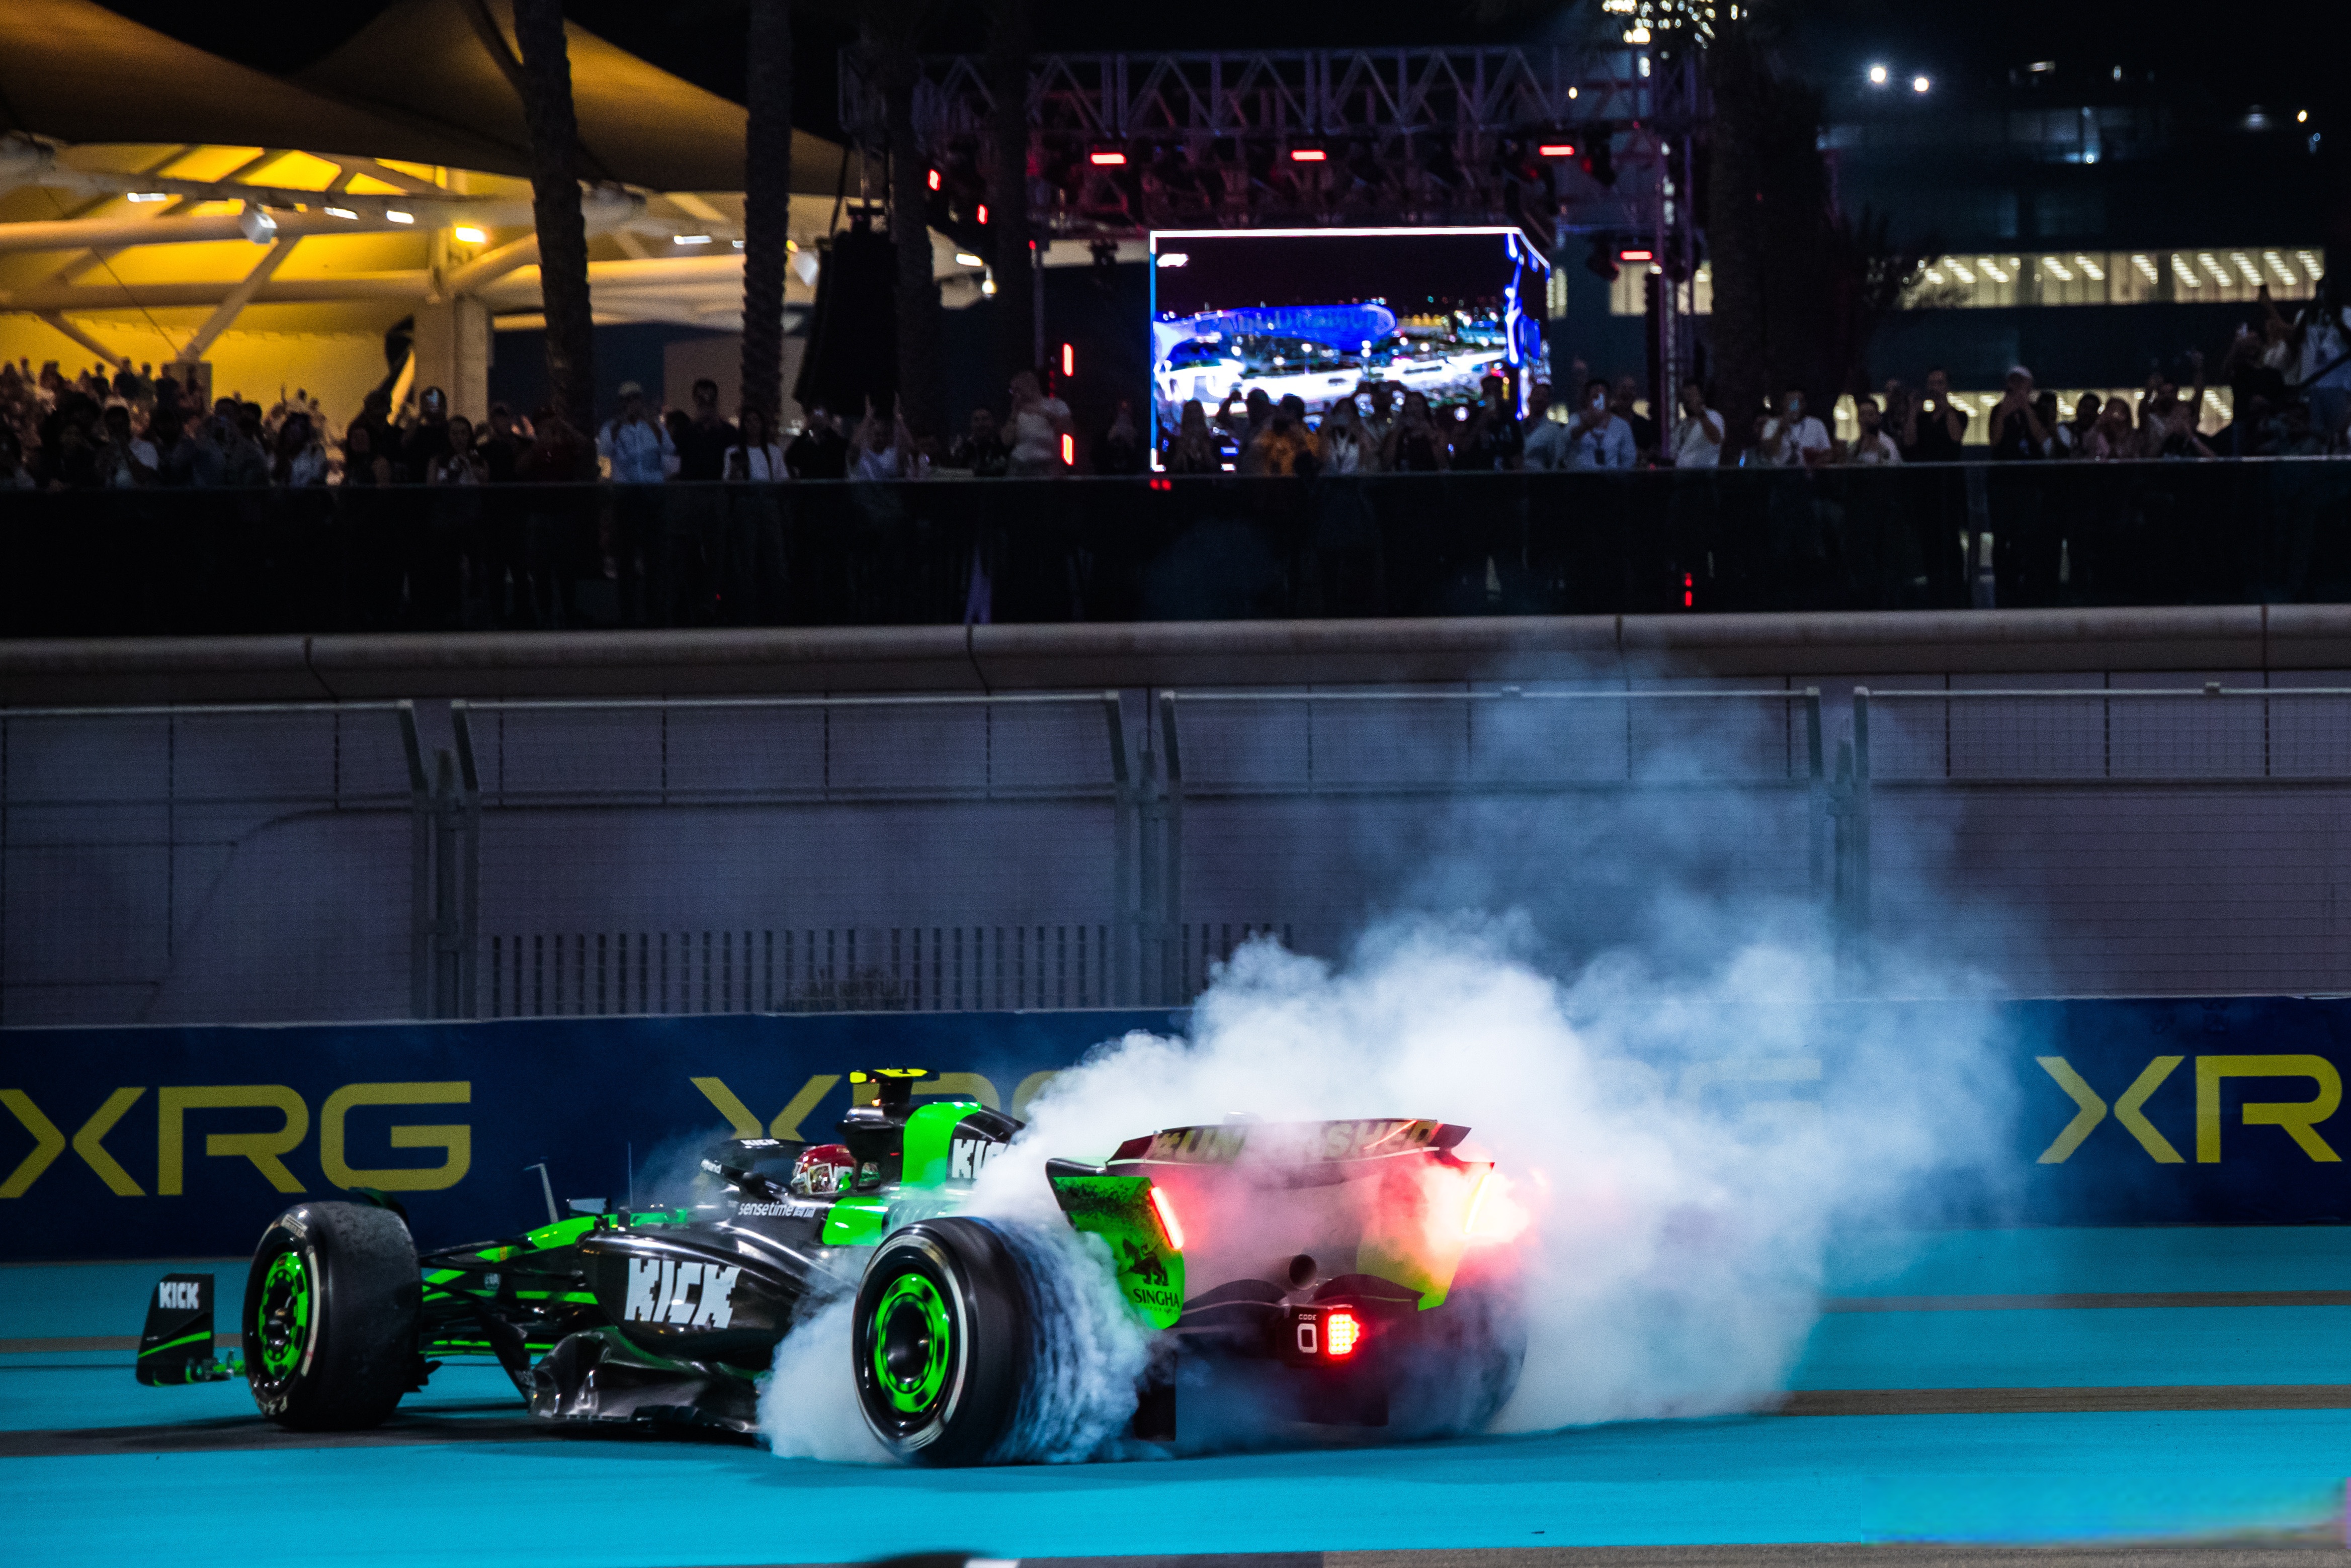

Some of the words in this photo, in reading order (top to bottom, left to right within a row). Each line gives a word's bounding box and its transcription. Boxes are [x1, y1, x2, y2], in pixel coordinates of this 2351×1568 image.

[0, 1082, 471, 1198] XRG
[738, 1201, 794, 1216] sensetime
[159, 1281, 199, 1309] KICK
[624, 1258, 741, 1329] KICK
[1133, 1288, 1180, 1308] SINGHA
[1297, 1323, 1318, 1353] 0
